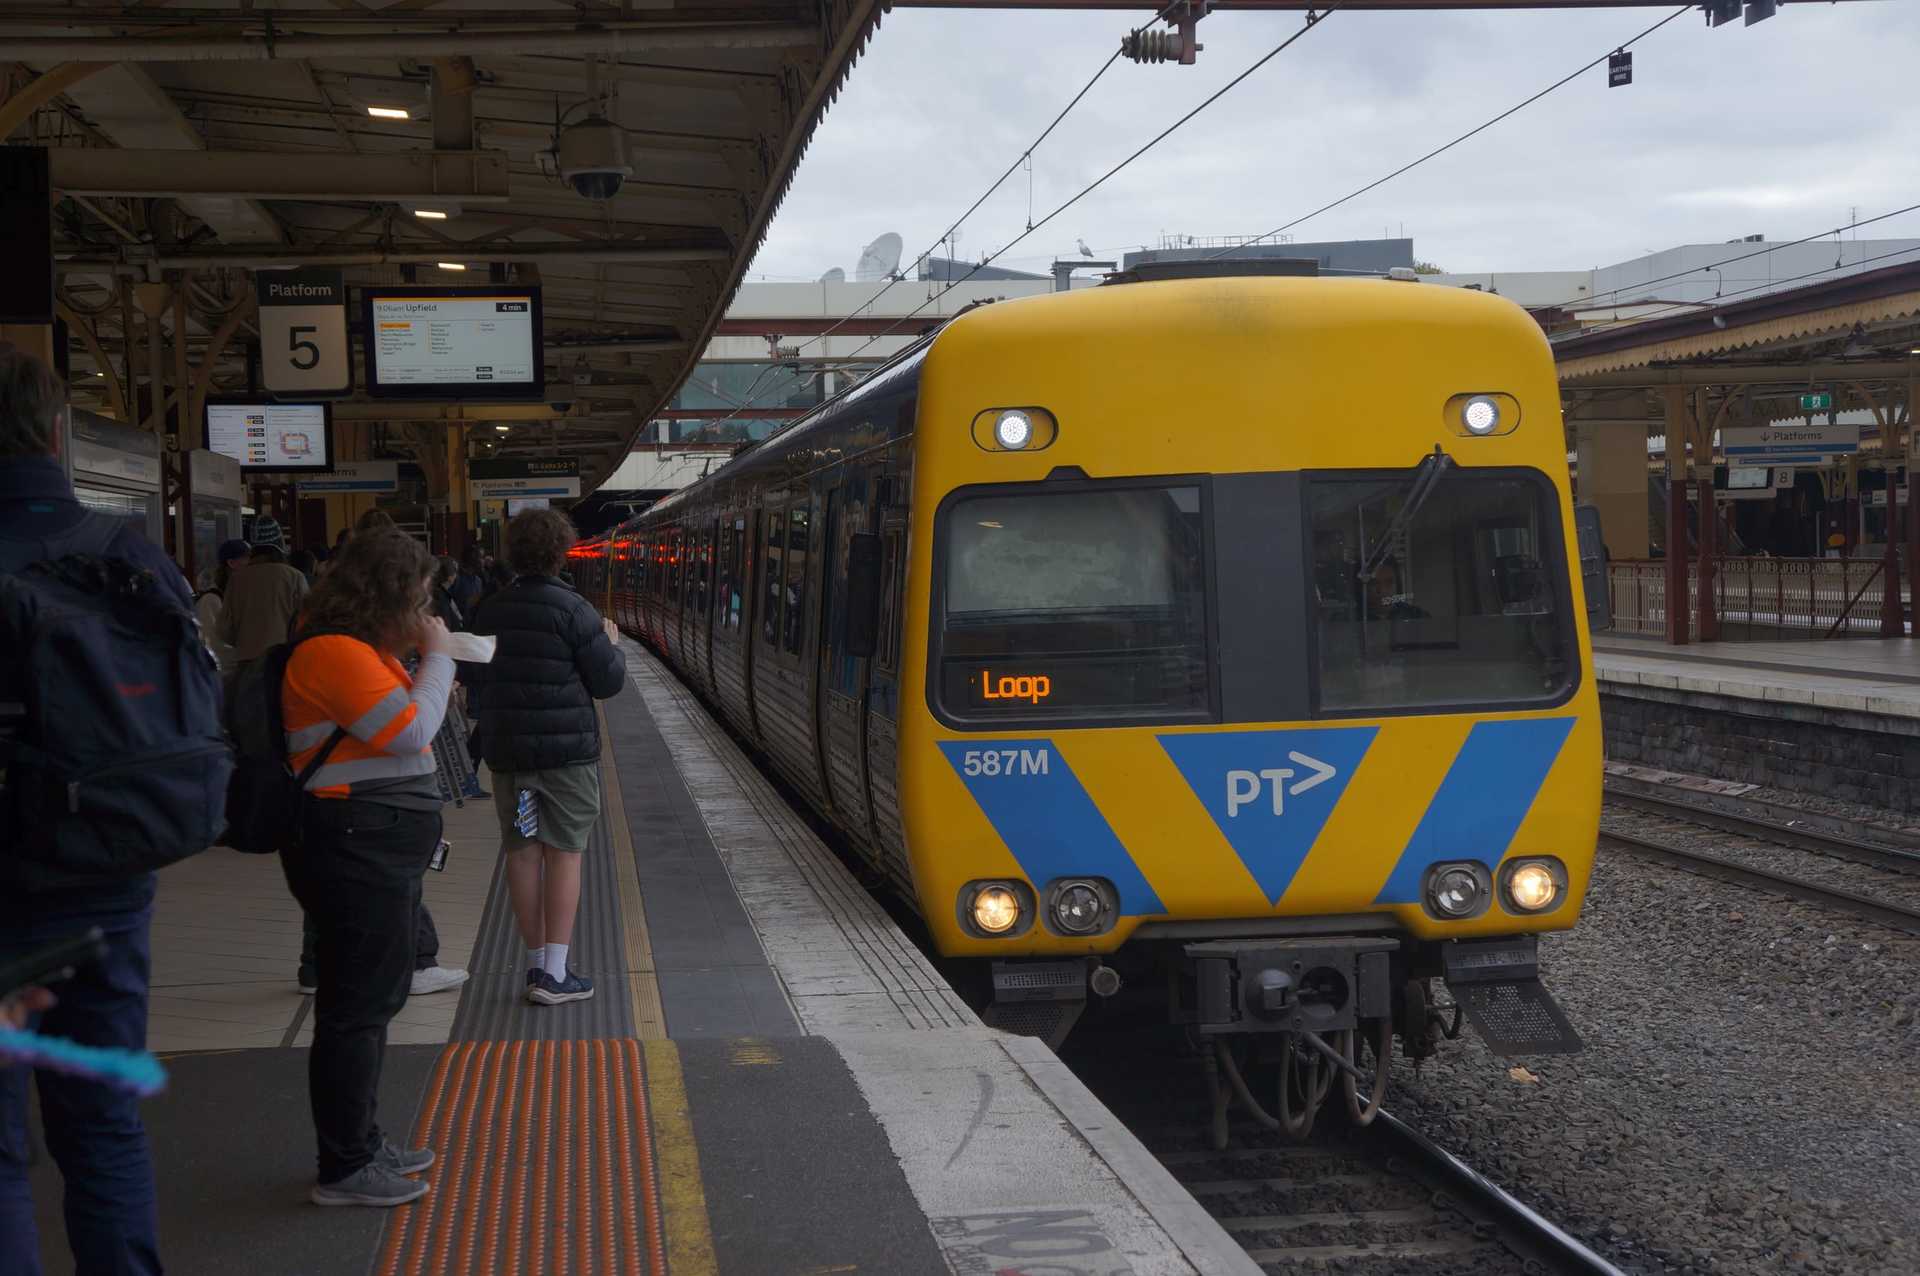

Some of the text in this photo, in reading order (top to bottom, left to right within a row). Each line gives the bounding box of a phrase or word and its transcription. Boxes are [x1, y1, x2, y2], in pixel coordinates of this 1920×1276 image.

[268, 284, 332, 297] Platform
[406, 303, 437, 313] Upfield
[288, 325, 320, 371] 5
[1773, 431, 1823, 441] Platforms
[1779, 471, 1788, 484] 8
[983, 670, 1051, 704] Loop
[963, 748, 1049, 777] 587M
